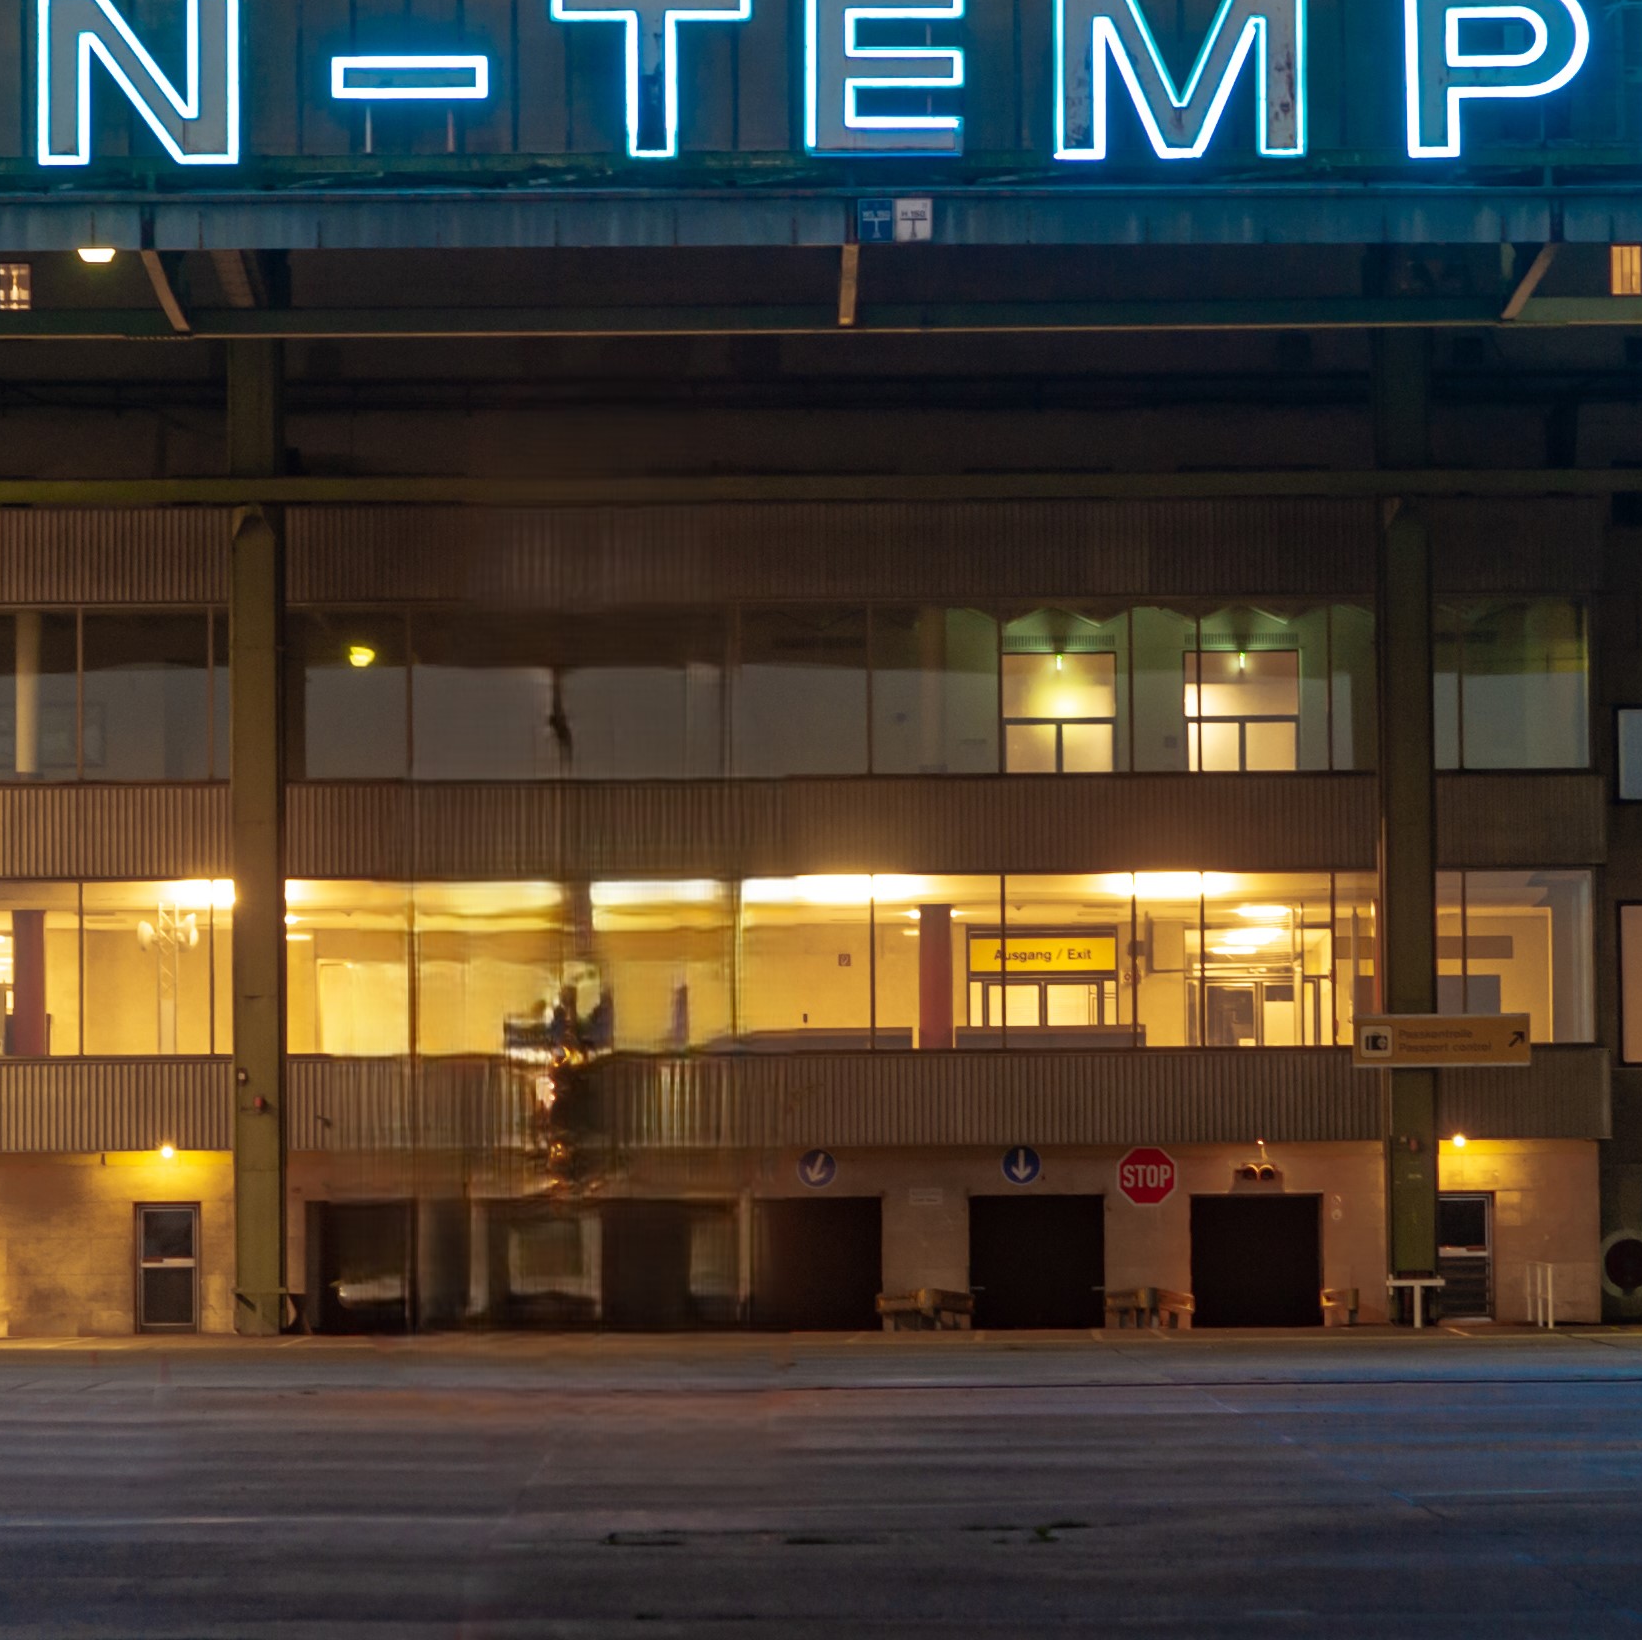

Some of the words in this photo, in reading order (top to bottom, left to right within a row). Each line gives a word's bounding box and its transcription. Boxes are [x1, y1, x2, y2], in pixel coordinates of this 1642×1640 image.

[994, 949, 1052, 962] Ausgang
[1067, 948, 1092, 960] Exit
[1398, 1042, 1449, 1054] Passport
[1452, 1041, 1492, 1052] control
[1123, 1164, 1172, 1188] STOP
